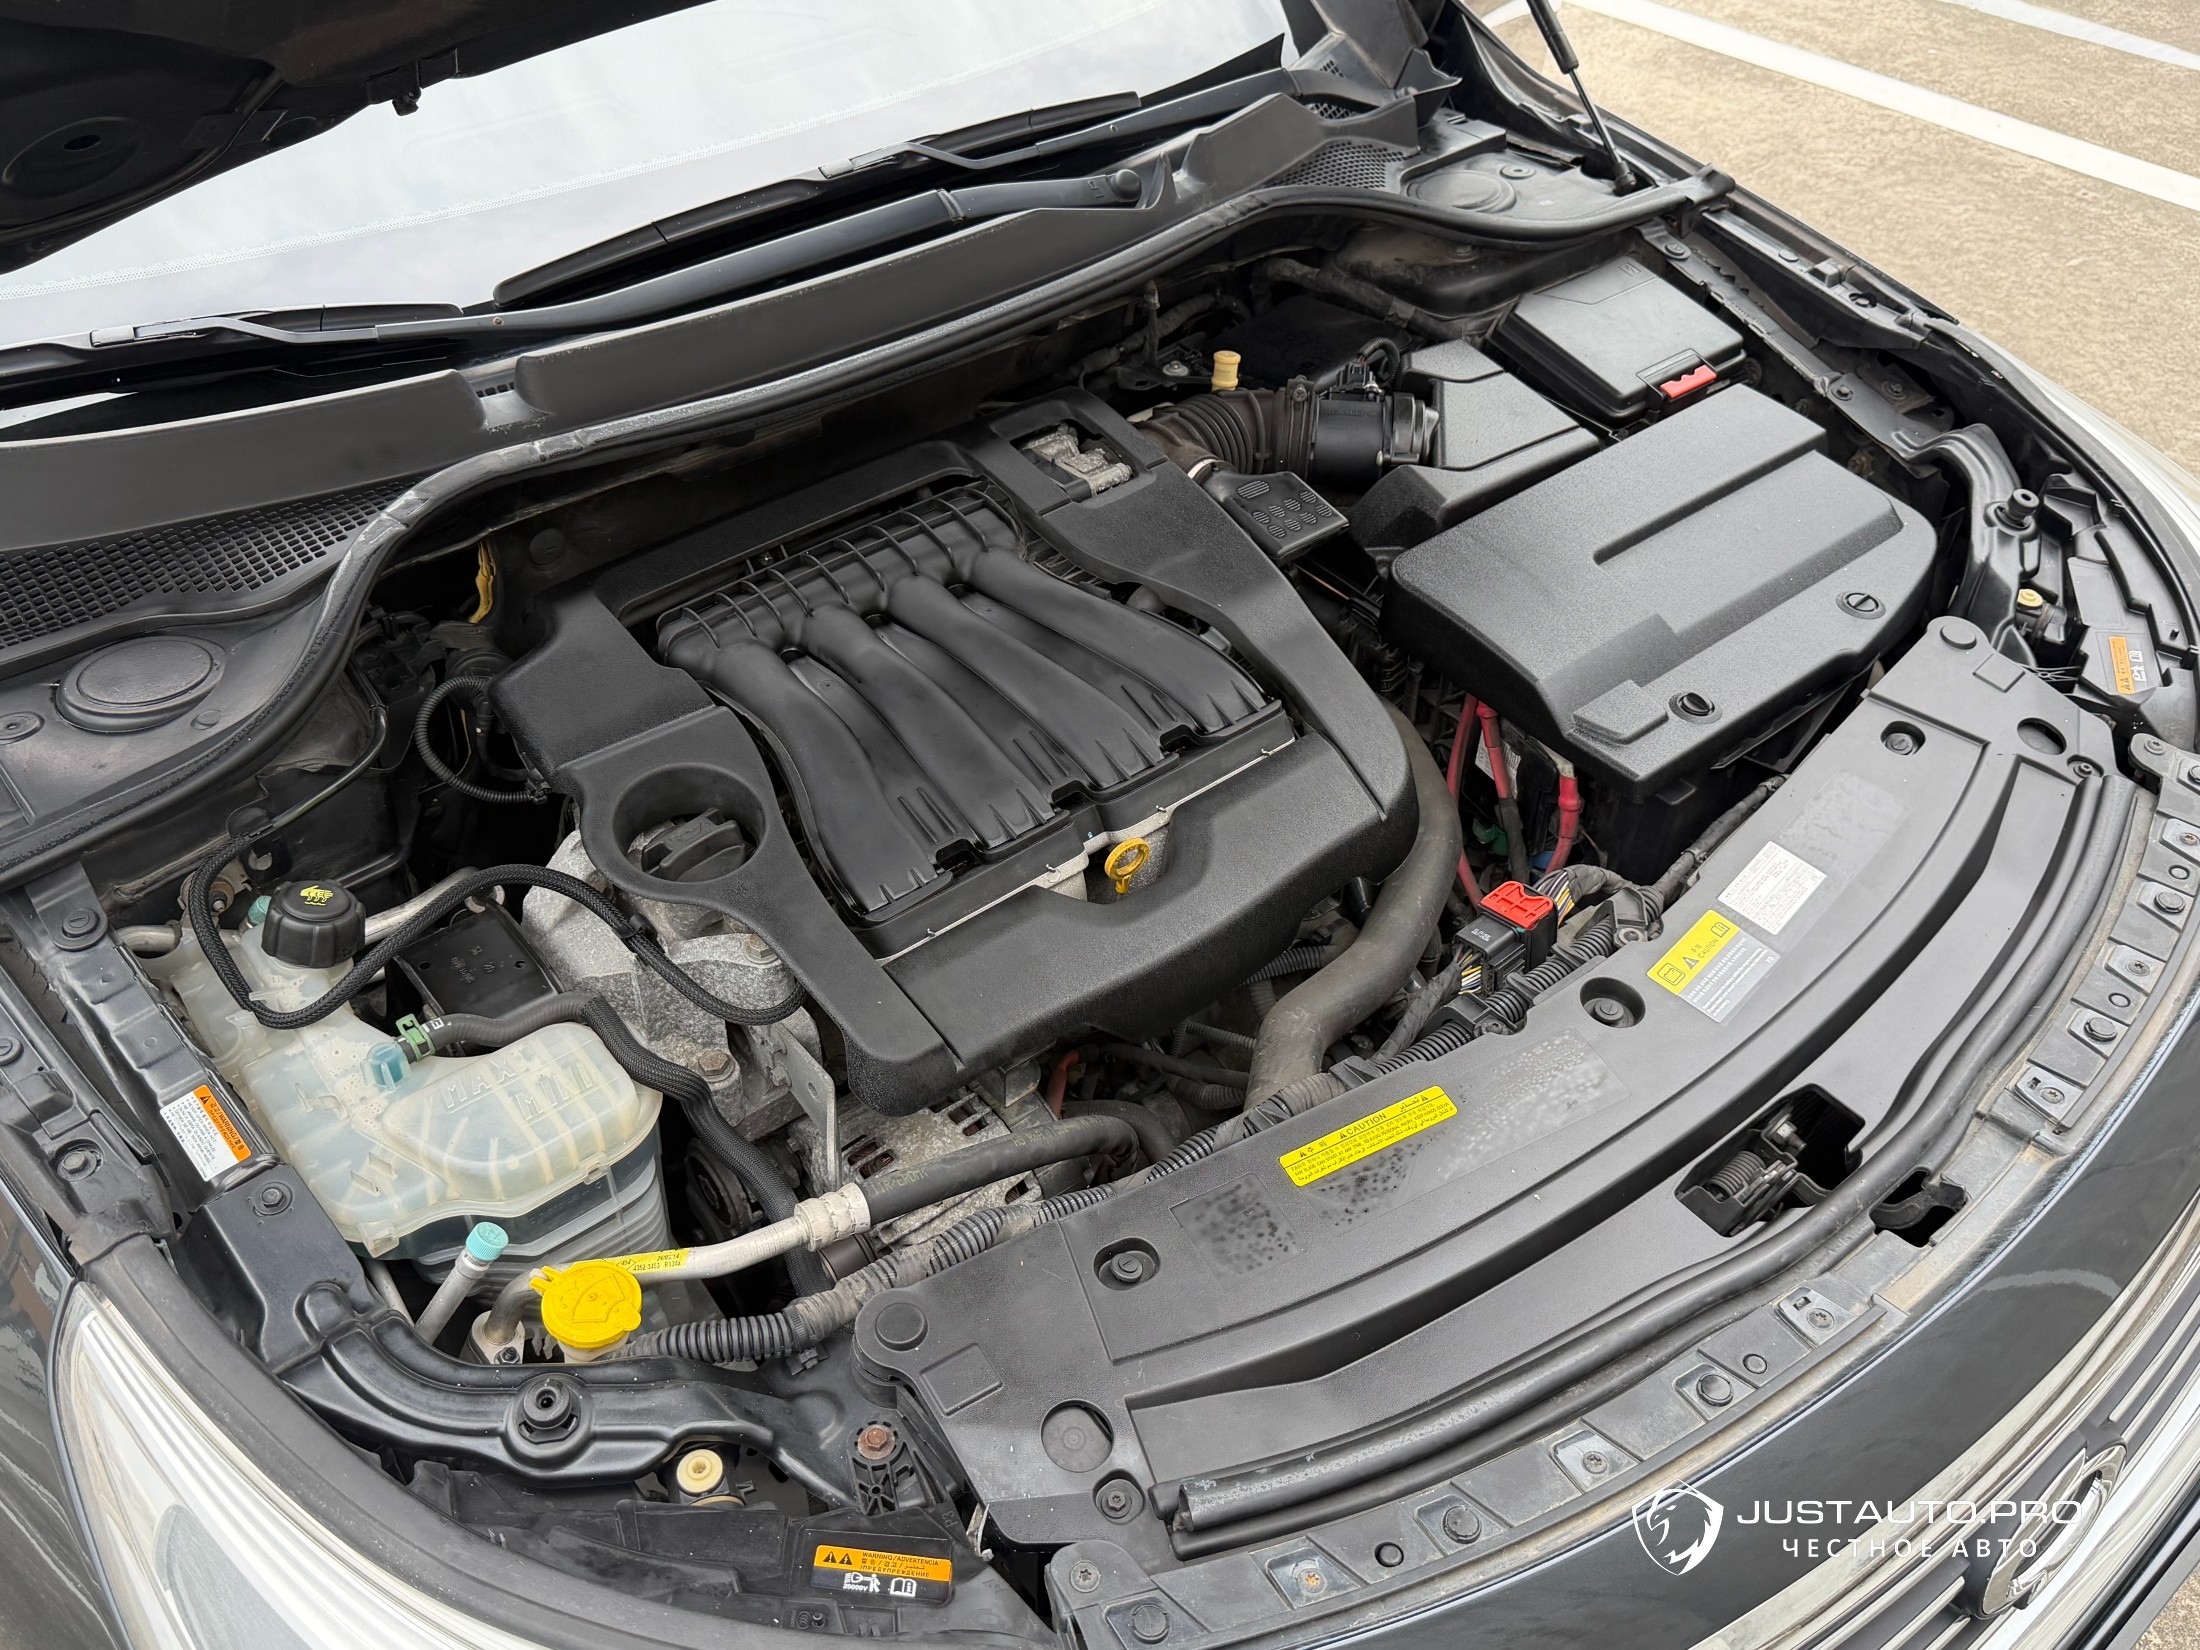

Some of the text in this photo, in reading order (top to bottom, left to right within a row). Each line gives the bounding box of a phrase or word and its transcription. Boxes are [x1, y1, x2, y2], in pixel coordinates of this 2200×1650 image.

[440, 1054, 517, 1109] MAX
[1346, 1112, 1387, 1136] CAUTION
[842, 1582, 868, 1592] 20000V
